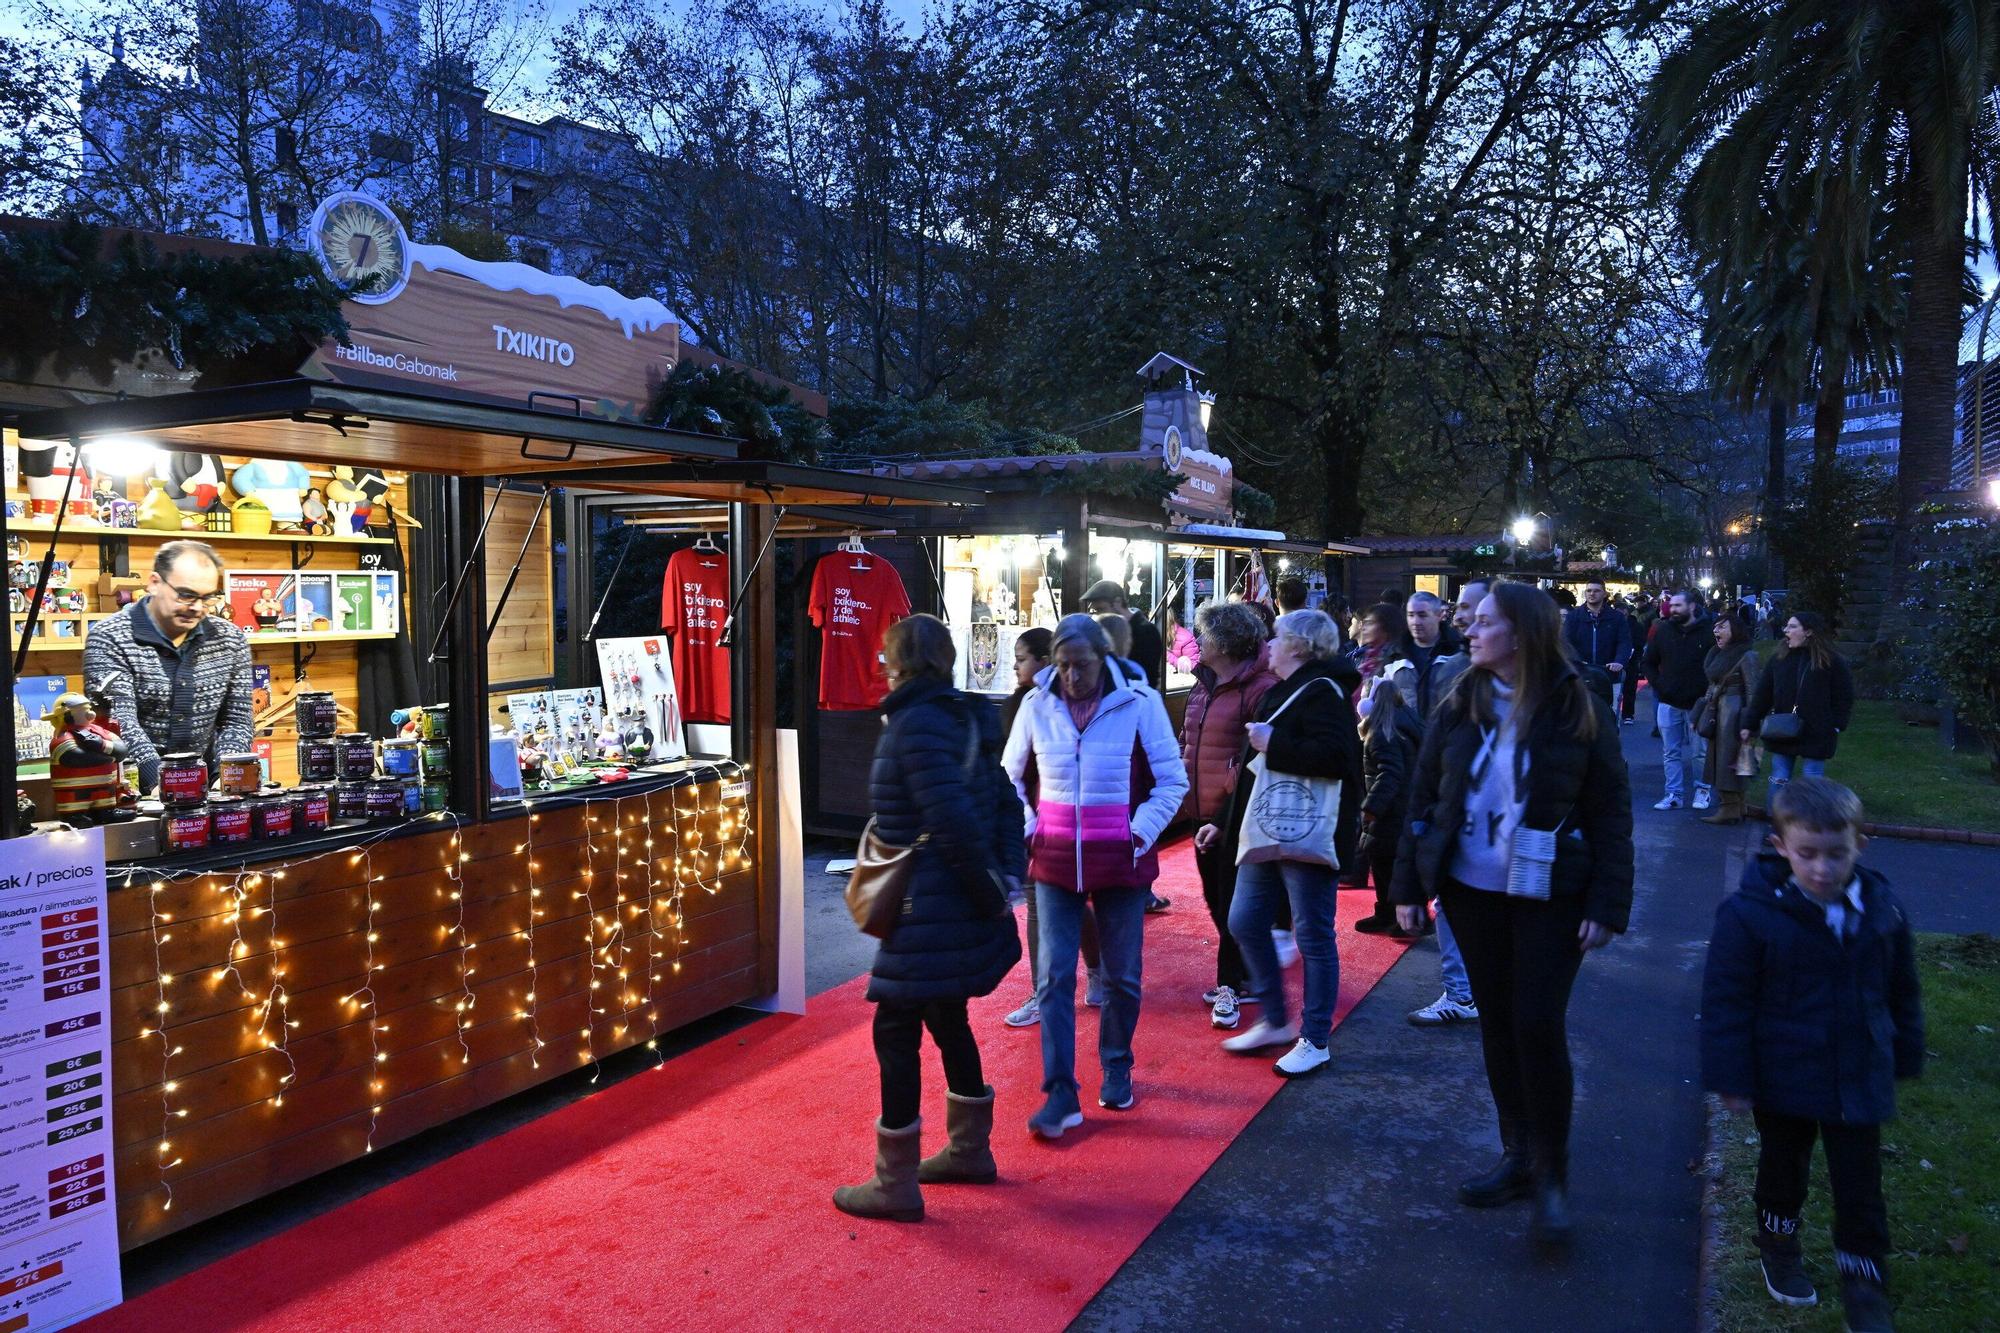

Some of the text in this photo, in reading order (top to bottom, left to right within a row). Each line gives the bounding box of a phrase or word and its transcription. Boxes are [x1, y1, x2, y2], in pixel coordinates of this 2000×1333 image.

[351, 232, 371, 268] 7
[492, 323, 576, 368] TXIKITO
[336, 342, 458, 383] #BilbaoGabonak
[230, 578, 267, 588] Eneko
[300, 575, 330, 583] abonak
[376, 583, 390, 591] sia
[684, 582, 702, 595] soy
[834, 587, 850, 598] soy
[833, 606, 839, 615] y
[165, 771, 187, 779] alubia
[223, 767, 244, 776] gilda
[171, 819, 194, 829] alubia
[217, 814, 239, 823] alubia
[0, 875, 21, 891] ak
[36, 865, 94, 888] precios
[0, 906, 37, 919] likadura
[45, 895, 98, 911] alimentación
[62, 912, 78, 924] 6€
[63, 929, 79, 941] 6€
[58, 963, 86, 978] 7,50€
[61, 981, 85, 995] 15€
[62, 1017, 85, 1030] 45€
[66, 1057, 82, 1069] 8€
[63, 1078, 86, 1093] 20€
[64, 1101, 87, 1116] 25€
[66, 1161, 88, 1175] 19€
[66, 1178, 89, 1193] 22€
[66, 1195, 90, 1210] 26€
[15, 1271, 40, 1288] 27€
